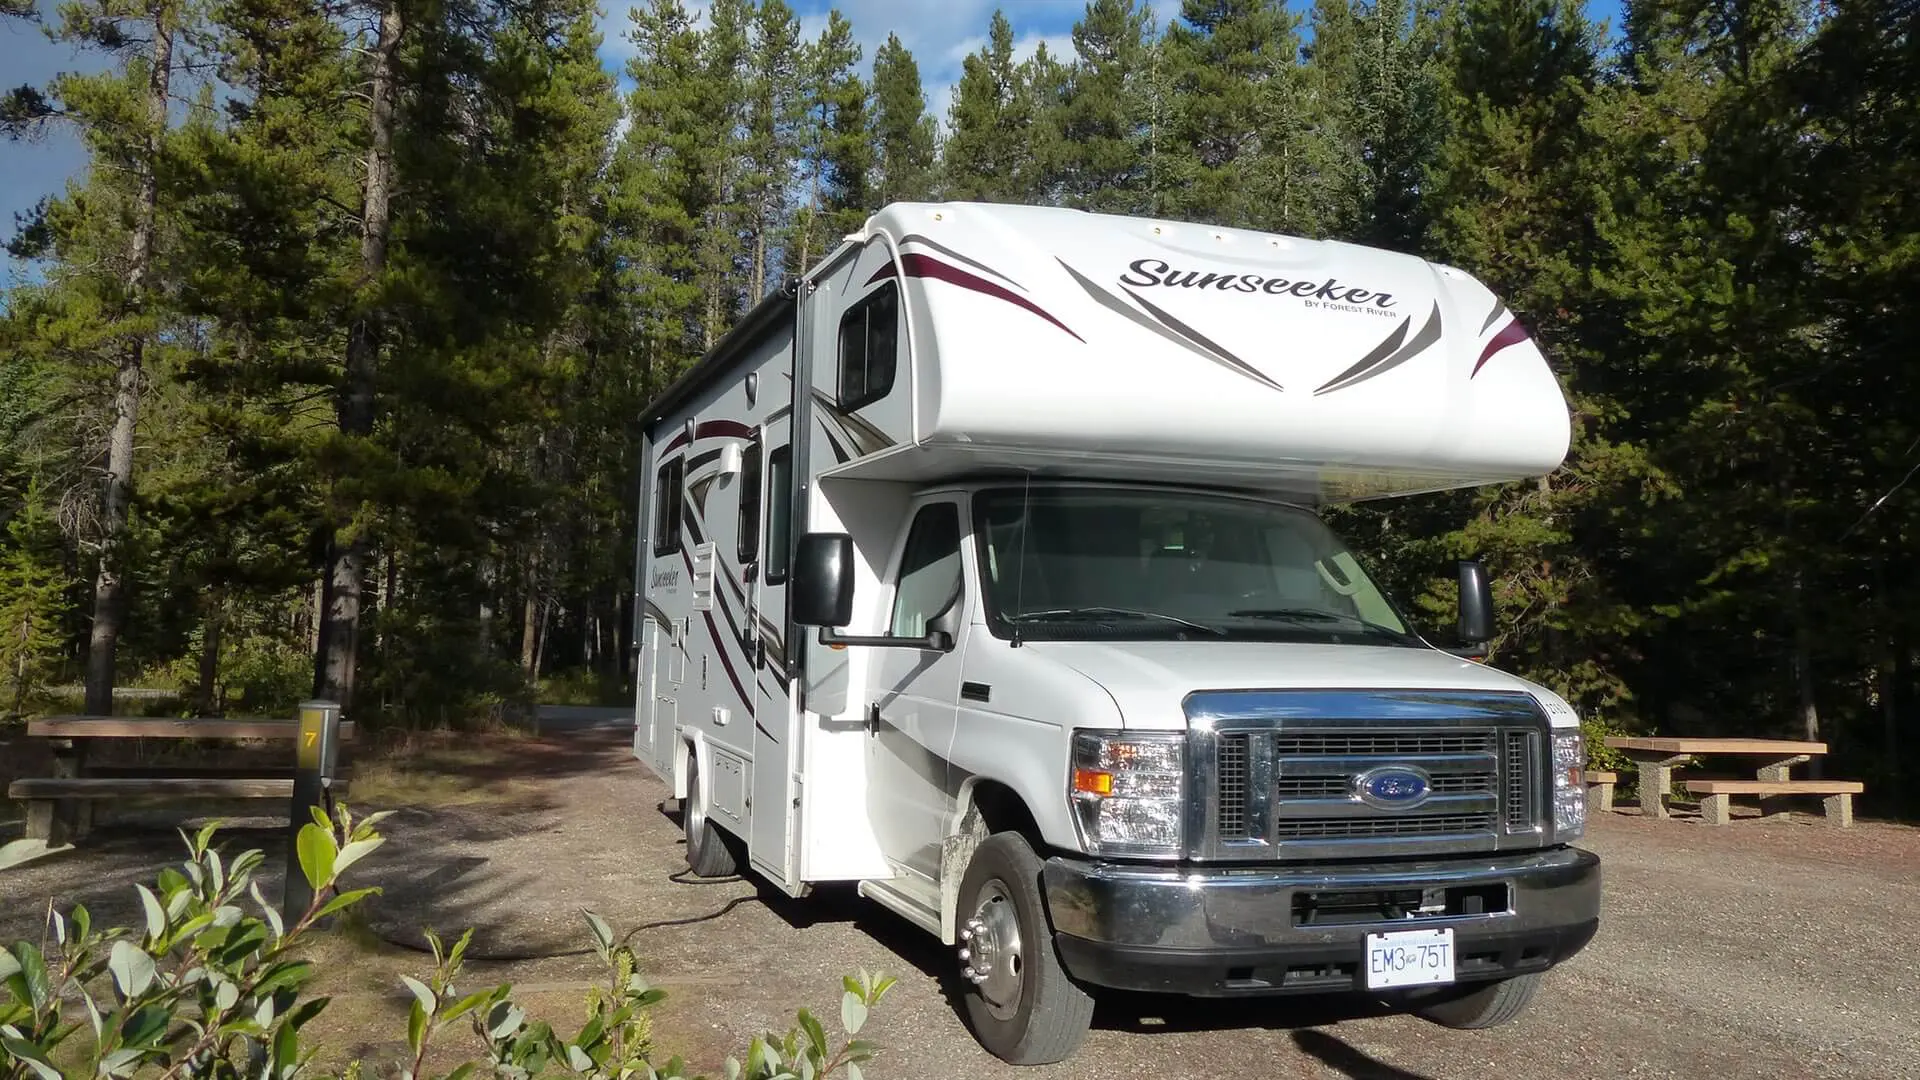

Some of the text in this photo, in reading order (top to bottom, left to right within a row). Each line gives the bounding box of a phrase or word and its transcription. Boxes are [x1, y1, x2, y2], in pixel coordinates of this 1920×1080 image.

[1119, 258, 1398, 308] Sunseeker
[1304, 300, 1397, 318] BY FOREST RIVER
[305, 731, 317, 747] 7
[1380, 778, 1416, 795] Ford
